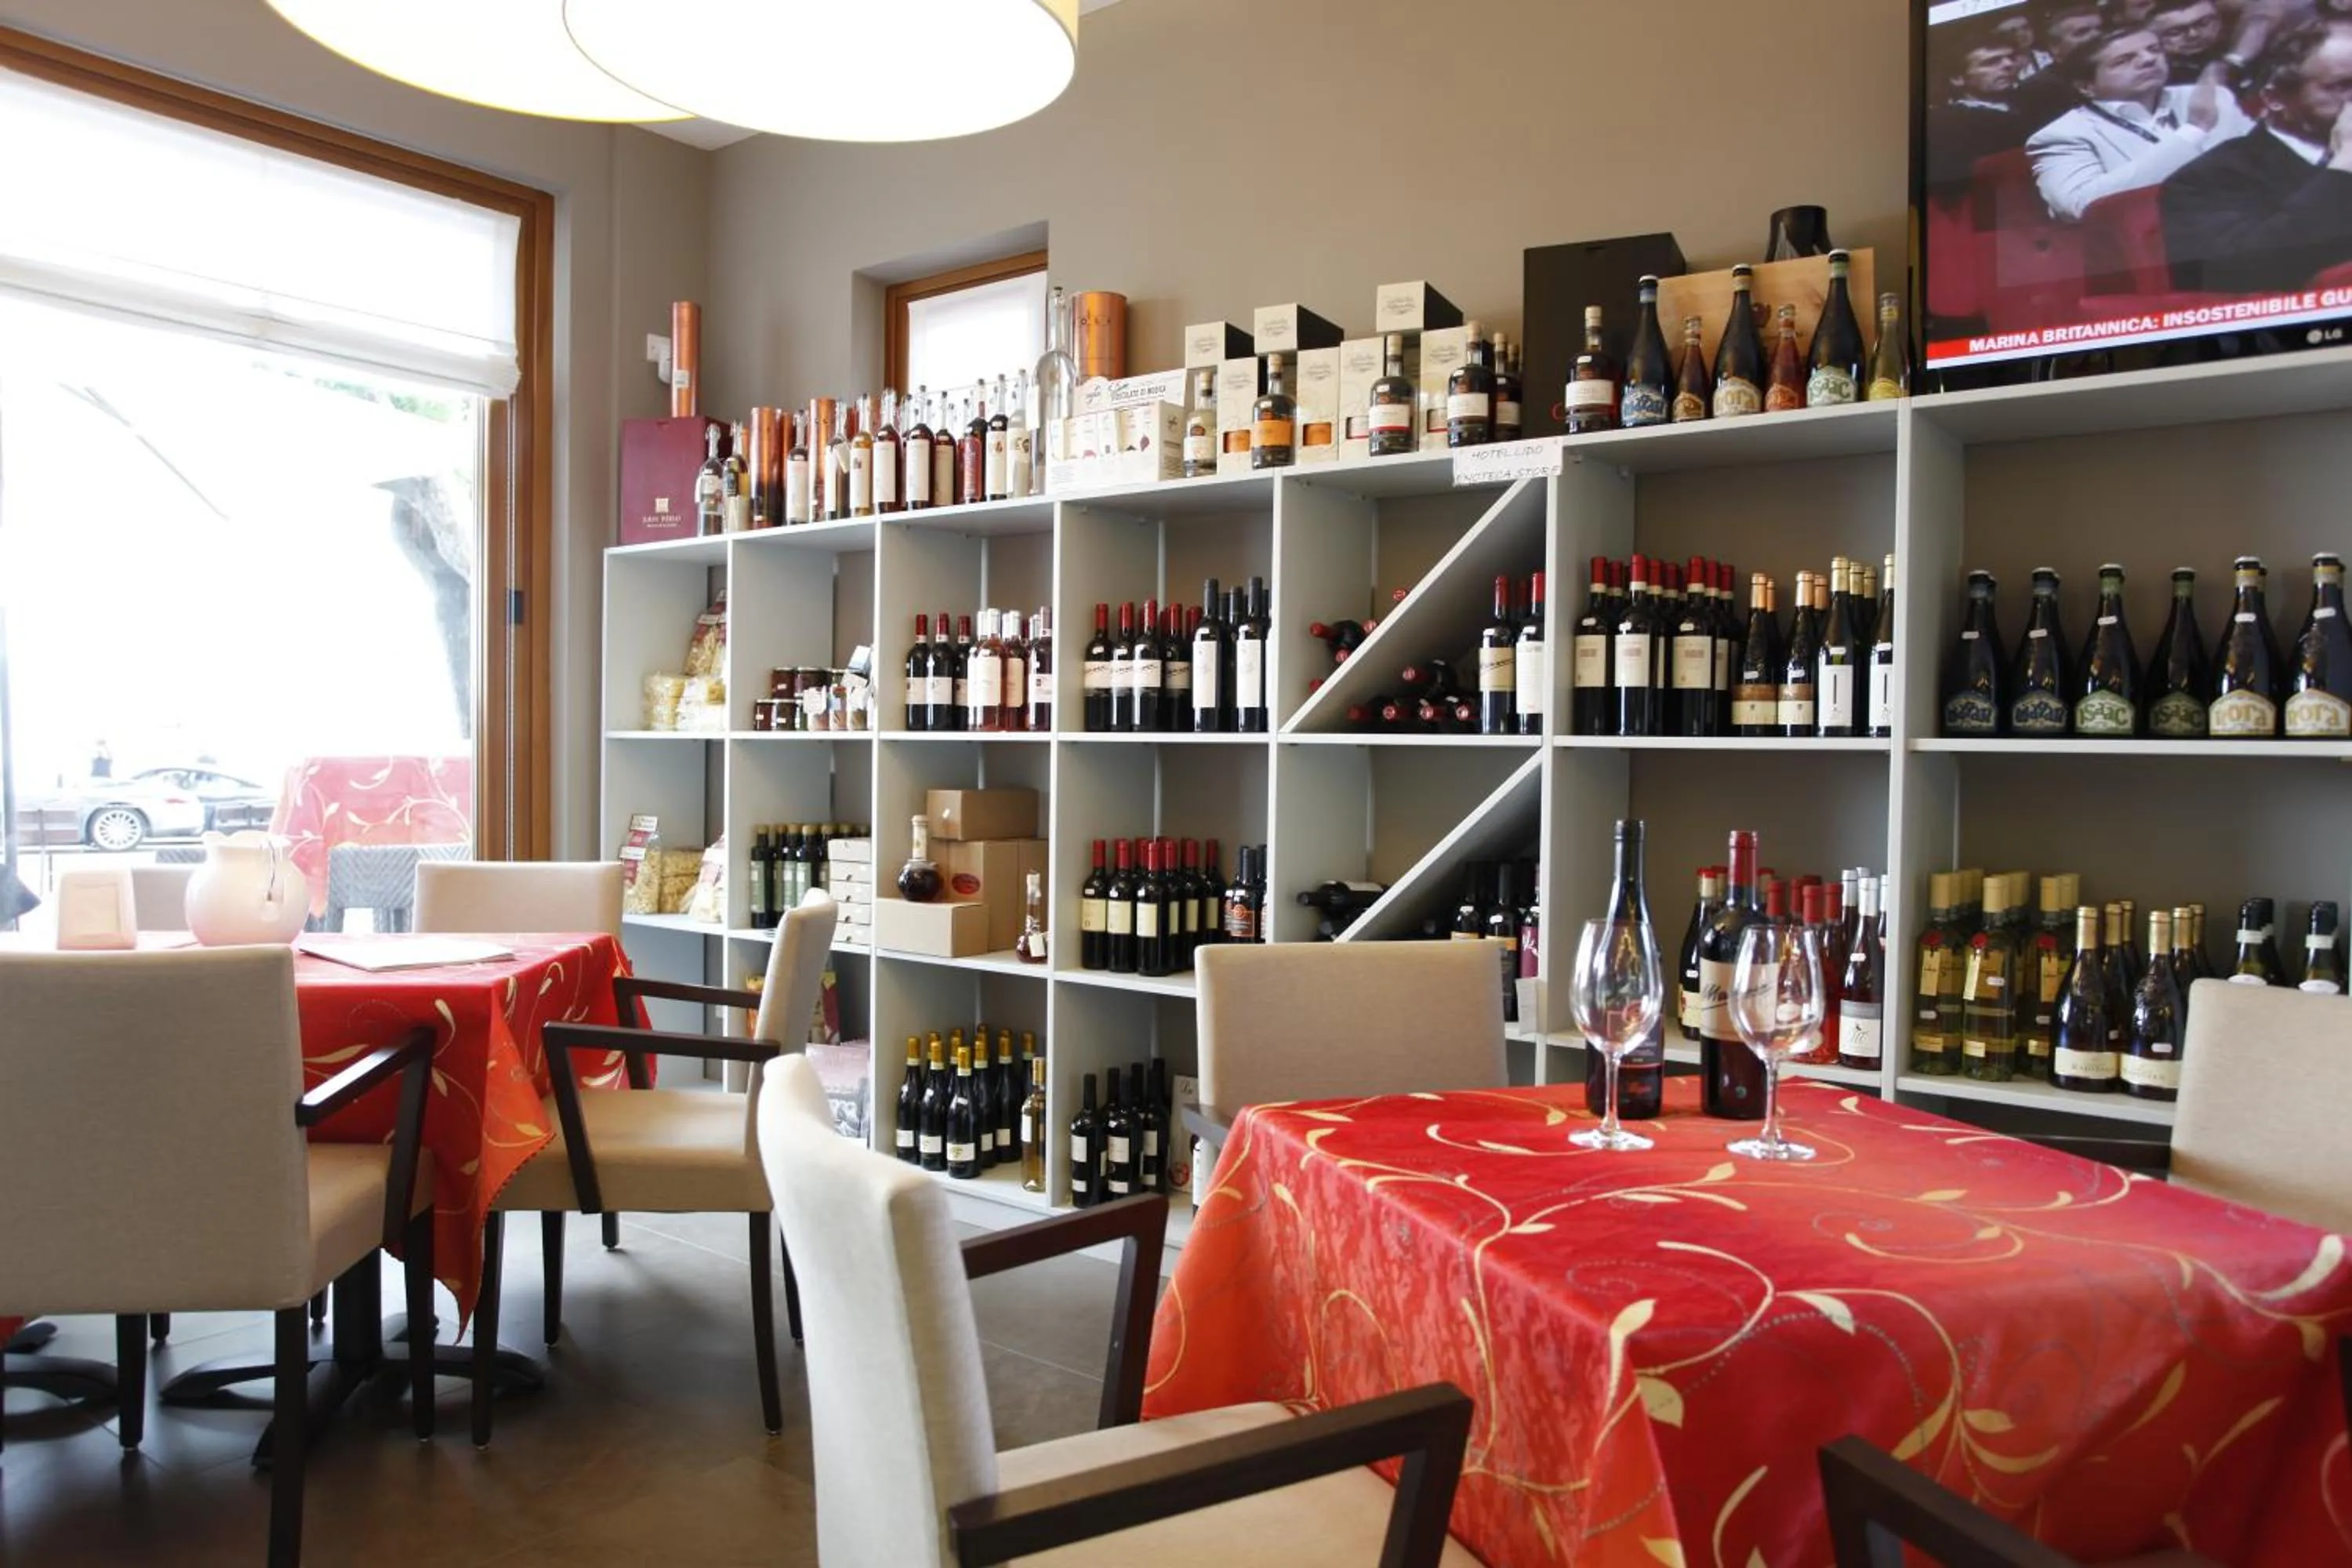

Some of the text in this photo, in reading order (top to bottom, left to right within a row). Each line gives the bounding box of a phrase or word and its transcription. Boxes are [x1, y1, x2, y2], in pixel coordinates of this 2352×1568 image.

[1969, 287, 2352, 353] MARINA BRITANNICA: INSOSTENIBILE GU
[2325, 328, 2343, 339] LG
